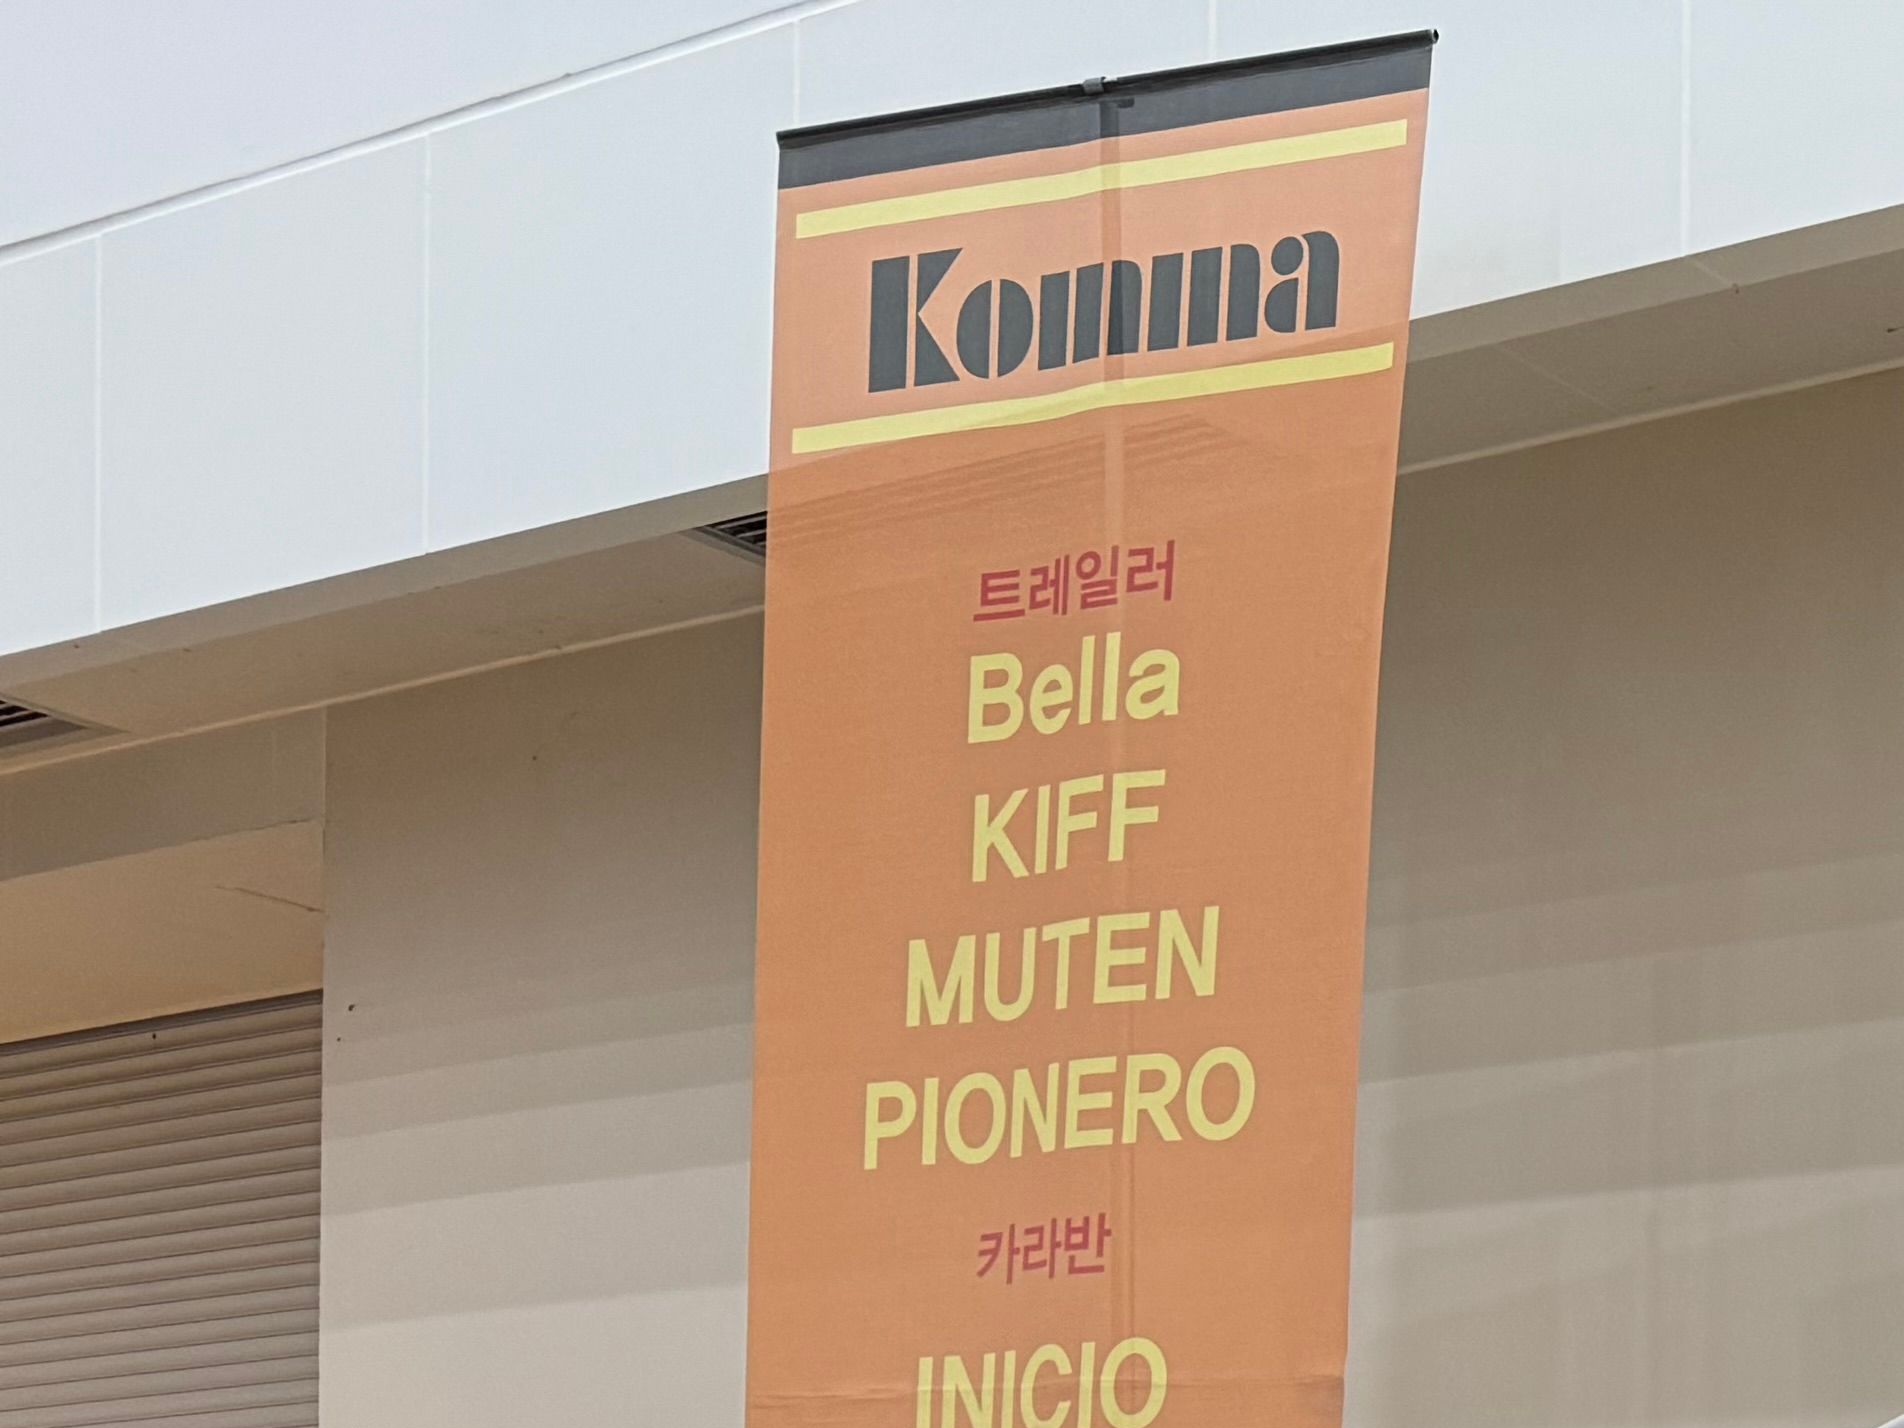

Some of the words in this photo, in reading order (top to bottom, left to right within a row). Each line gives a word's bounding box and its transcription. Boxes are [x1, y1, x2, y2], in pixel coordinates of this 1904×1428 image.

[867, 230, 1340, 393] Komma
[972, 540, 1176, 622] 트레일러
[968, 631, 1180, 743] Bella
[971, 769, 1167, 882] KIFF
[906, 906, 1219, 1027] MUTEN
[863, 1046, 1255, 1170] PIONERO
[976, 1212, 1111, 1284] 카라반
